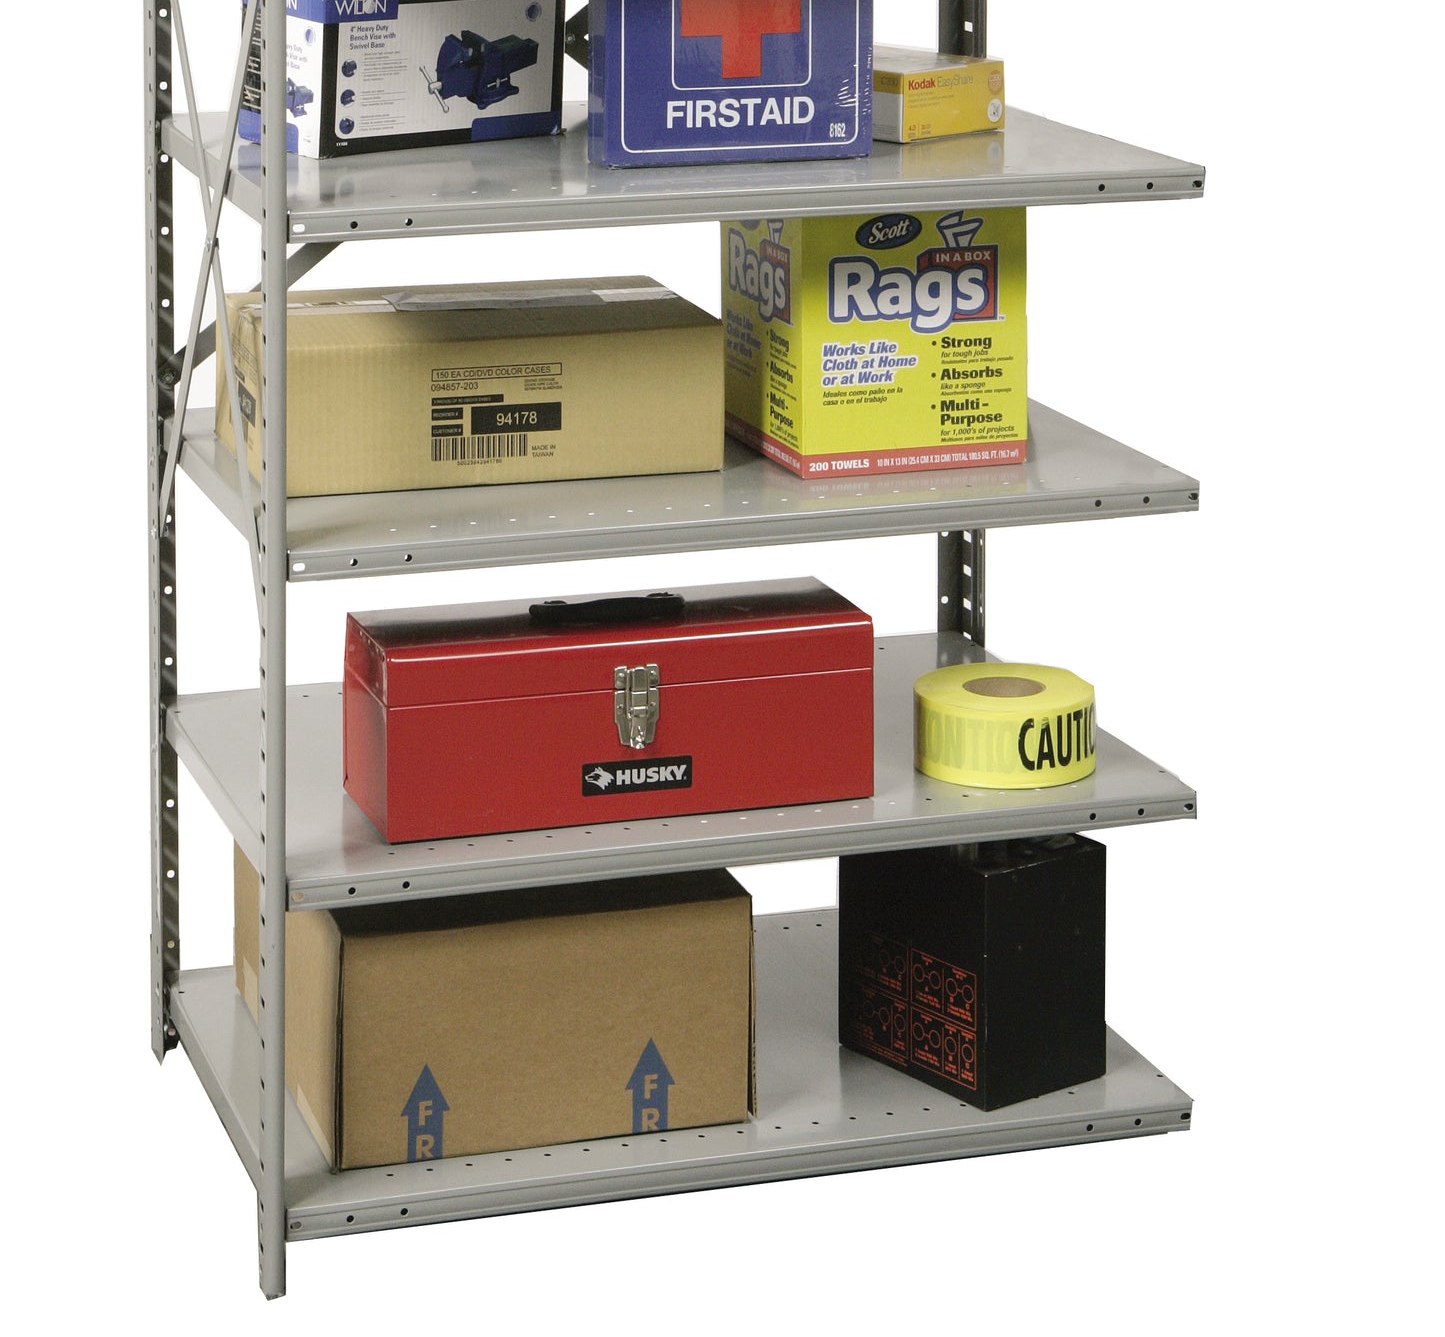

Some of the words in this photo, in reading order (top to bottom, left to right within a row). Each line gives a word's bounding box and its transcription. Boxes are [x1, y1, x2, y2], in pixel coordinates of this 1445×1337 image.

[357, 25, 375, 33] Heavy
[375, 24, 390, 33] Duty
[350, 33, 368, 42] Bench
[383, 32, 396, 40] with
[349, 42, 370, 50] Swivel
[908, 78, 936, 91] Kodak
[868, 218, 911, 244] Scott
[935, 253, 949, 263] IN
[950, 253, 961, 262] A
[964, 251, 991, 262] BOX
[728, 229, 787, 320] Rags
[831, 258, 988, 332] Rags
[941, 336, 992, 349] Strong
[823, 343, 866, 357] Works
[868, 342, 897, 354] Like
[952, 350, 972, 358] tough
[974, 348, 989, 357] jobs
[823, 358, 858, 371] Cloth
[861, 358, 875, 369] at
[878, 356, 917, 368] Home
[436, 371, 449, 379] 150
[451, 370, 462, 378] EA
[463, 369, 493, 377] CD/DVD
[495, 367, 523, 376] COLOR
[524, 365, 551, 374] CASES
[822, 376, 838, 386] or
[840, 374, 855, 385] at
[857, 370, 894, 384] Work
[941, 366, 1003, 381] Absorbs
[431, 381, 479, 392] 094857-203
[961, 382, 986, 390] sponge
[823, 390, 847, 398] Ideales
[864, 395, 887, 404] trabajo
[496, 411, 538, 426] 94178
[941, 413, 1003, 427] Purpose
[986, 425, 1014, 435] projects
[952, 452, 969, 461] TOTAL
[809, 462, 829, 472] 200
[831, 459, 870, 470] TOWELS
[616, 764, 687, 785] HUSKY
